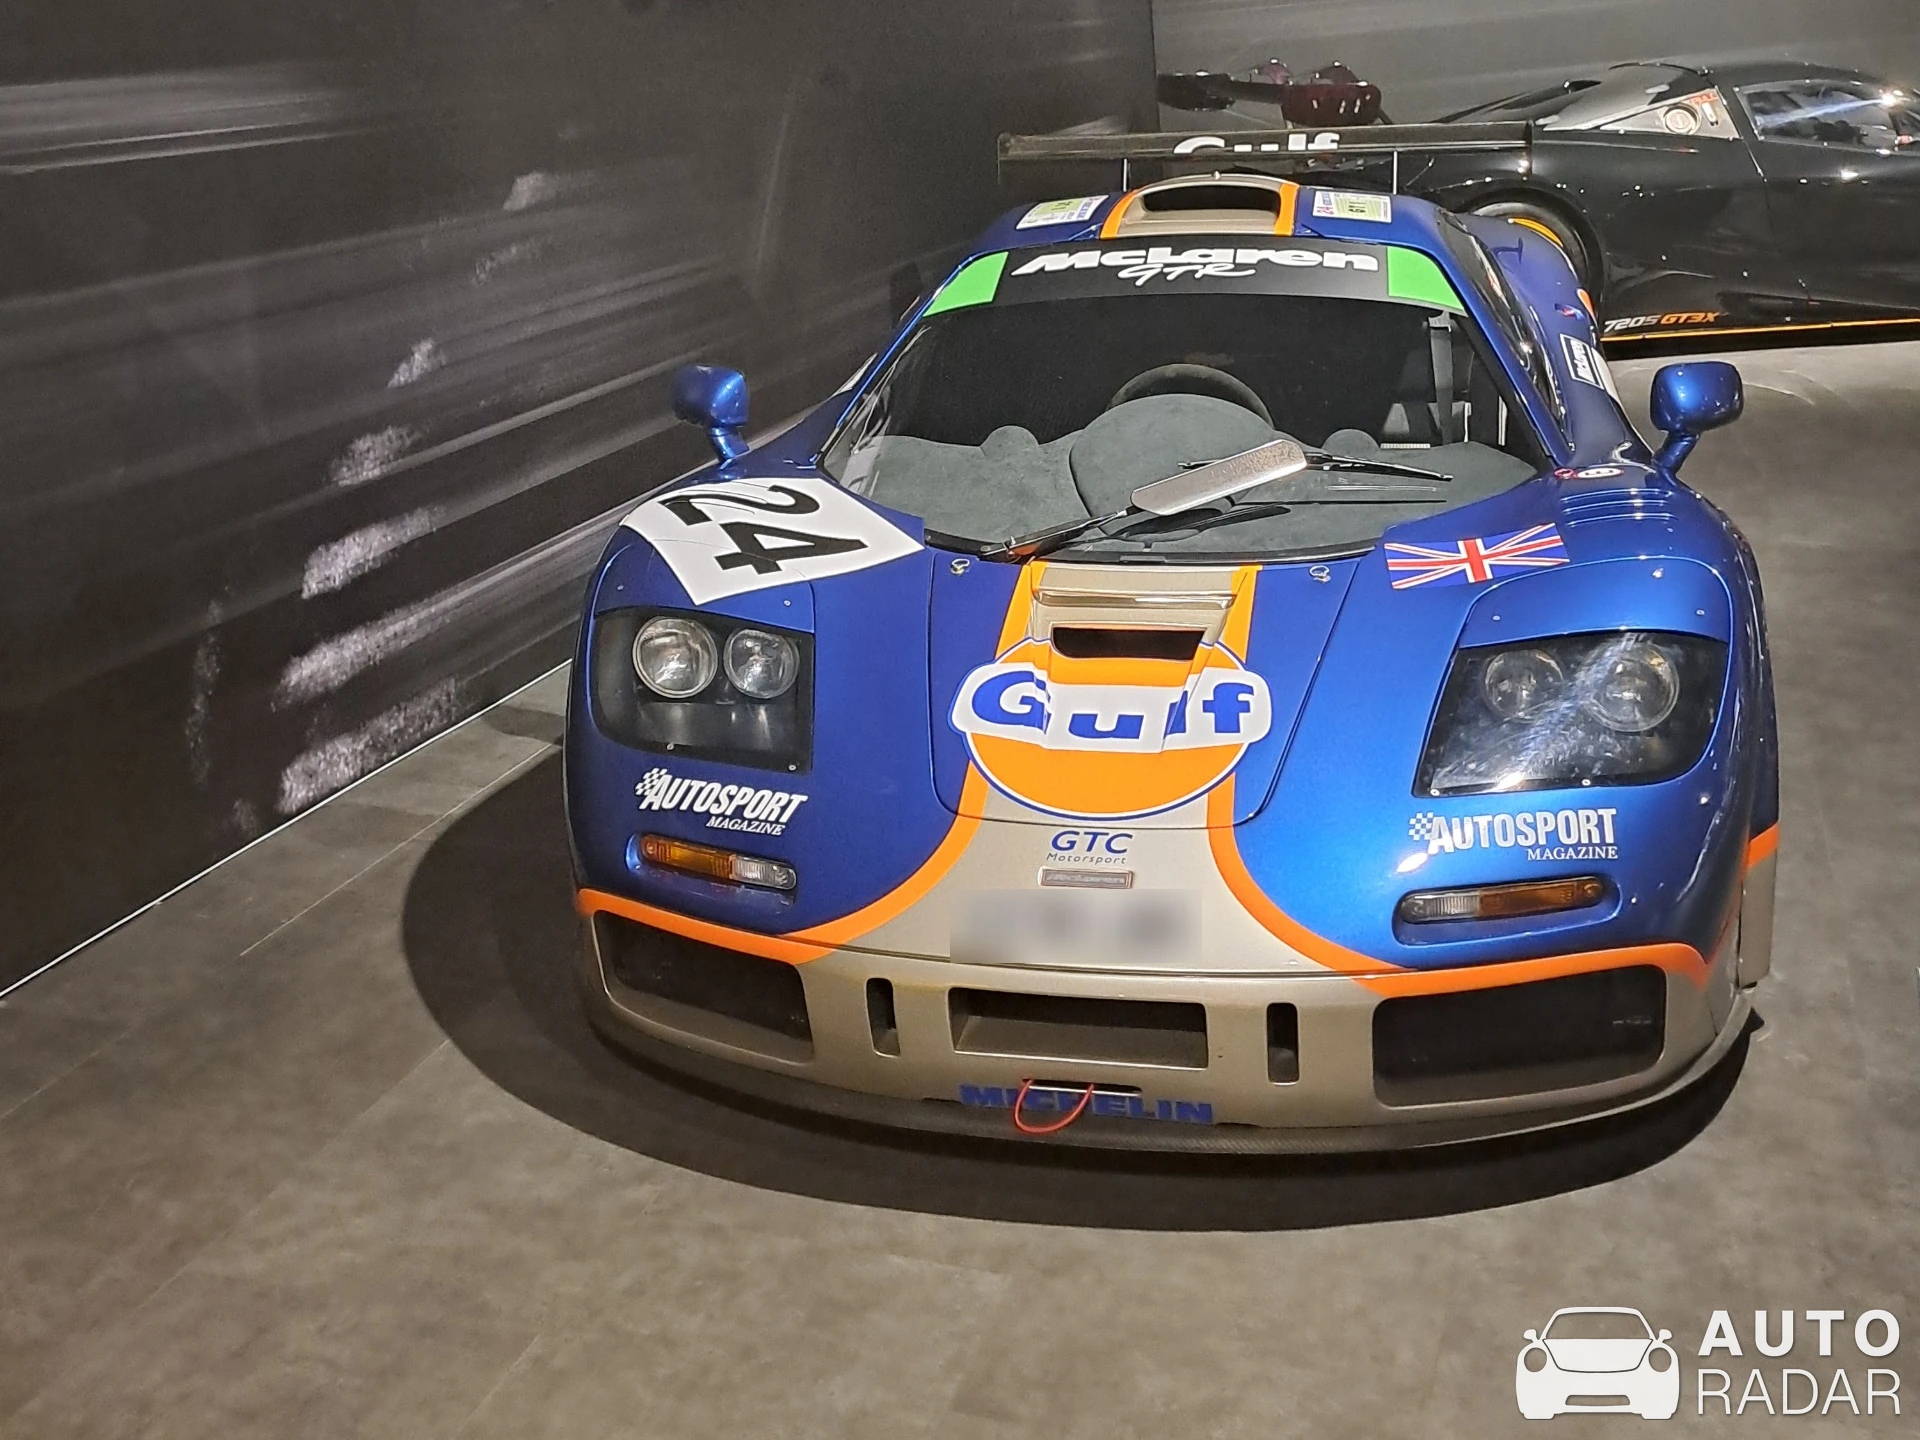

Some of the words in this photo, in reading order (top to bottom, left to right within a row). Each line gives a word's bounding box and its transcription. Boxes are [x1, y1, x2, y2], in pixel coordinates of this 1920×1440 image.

[1173, 132, 1340, 154] Glf
[1011, 248, 1379, 276] McLaren
[1118, 263, 1256, 287] GTR
[1603, 314, 1661, 333] 720S
[1660, 311, 1724, 325] GT3X
[657, 485, 869, 575] 24
[972, 671, 1255, 739] Gulf
[639, 774, 809, 823] AUTOSPORT
[706, 816, 786, 836] MAGAZINE
[1427, 808, 1617, 854] AUTOSPORT
[1051, 830, 1134, 854] GTC
[1527, 845, 1619, 861] MAGAZINE
[1046, 852, 1127, 865] Motorsport
